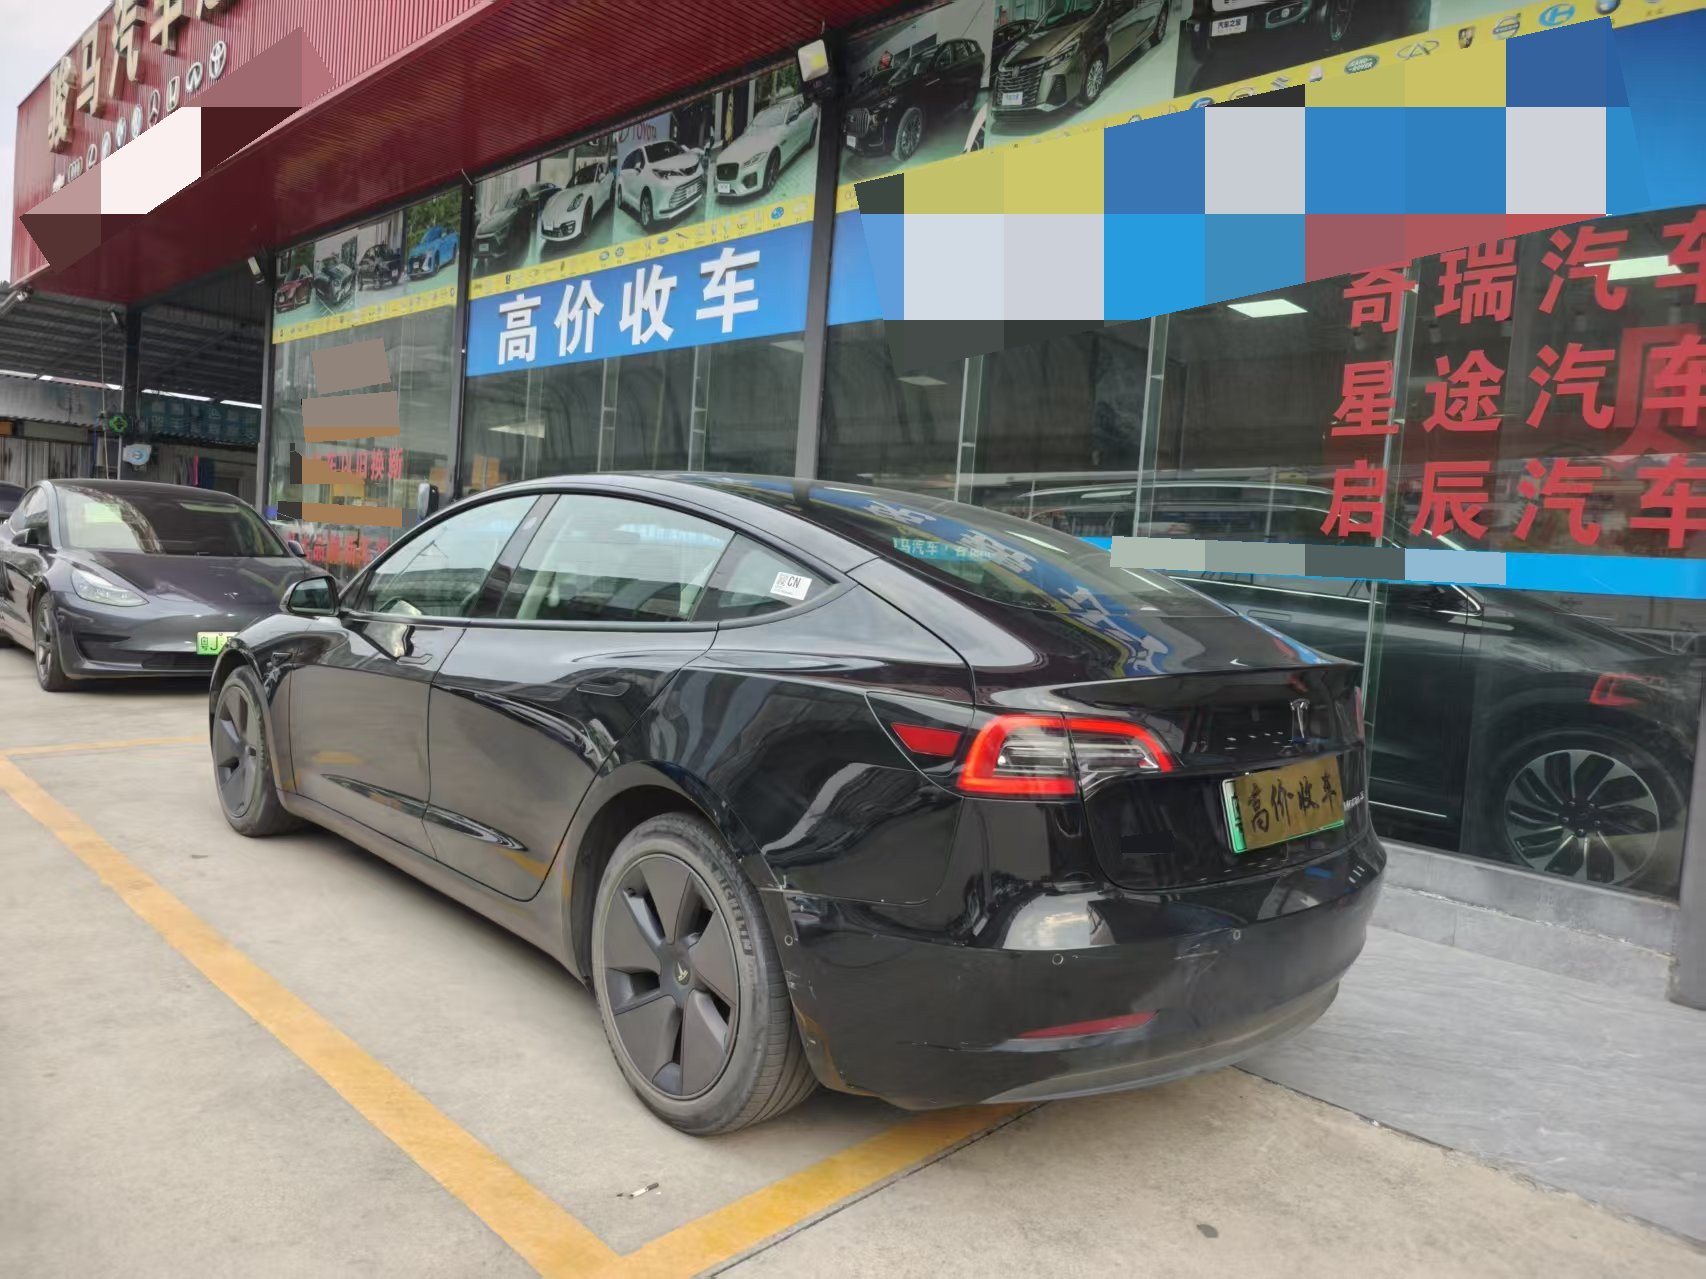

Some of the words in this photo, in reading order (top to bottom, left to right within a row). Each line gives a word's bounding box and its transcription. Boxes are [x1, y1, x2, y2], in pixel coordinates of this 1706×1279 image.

[498, 247, 760, 365] 高价收车
[1344, 209, 1706, 334] 奇瑞汽车
[1331, 334, 1706, 436] 星途汽车
[1320, 454, 1706, 547] 启辰汽车
[787, 576, 802, 589] CN
[1247, 772, 1337, 833] 高价收车
